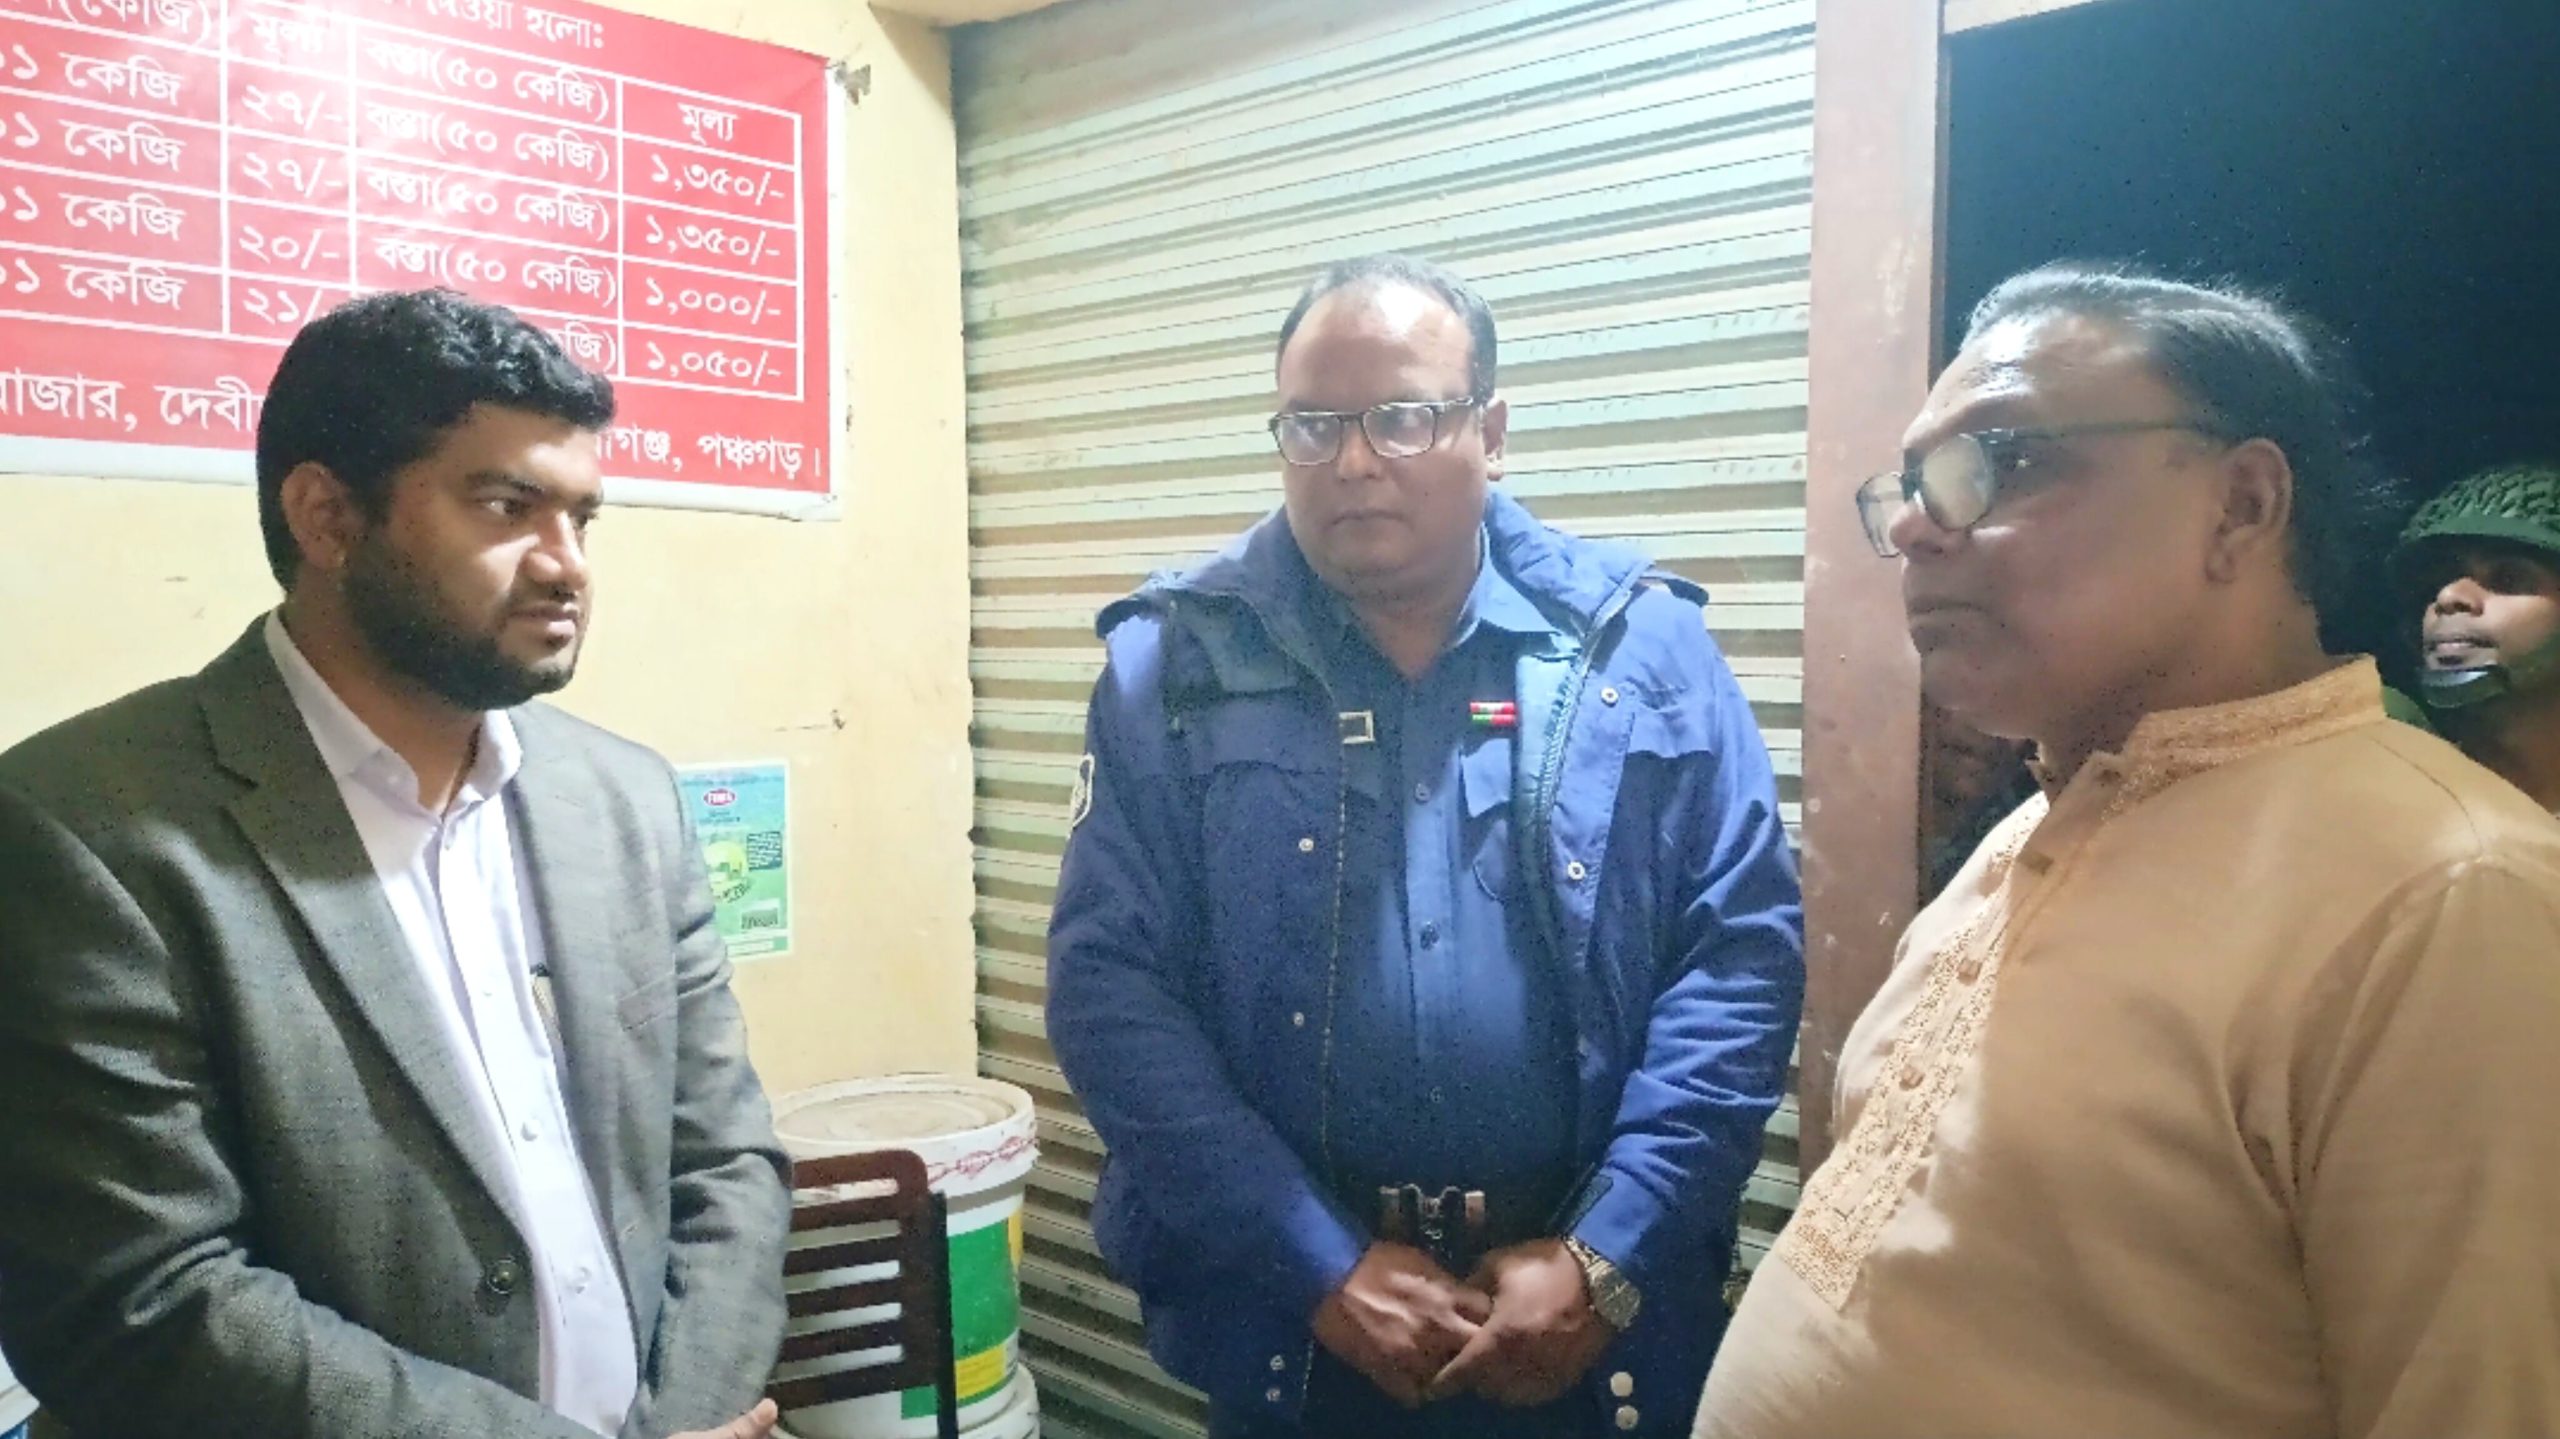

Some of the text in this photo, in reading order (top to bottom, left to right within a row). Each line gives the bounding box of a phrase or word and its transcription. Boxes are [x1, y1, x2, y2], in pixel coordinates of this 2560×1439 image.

[0, 44, 186, 106] ১ কেজি
[513, 66, 609, 122] কেজি)
[240, 84, 344, 132] ২৭/-
[678, 102, 739, 146] মূল্য
[0, 112, 187, 172] ১ কেজি
[514, 128, 609, 182] কেজি)
[241, 151, 344, 199] ২৭/-
[651, 153, 785, 206] ১,৩৫০/-
[0, 186, 187, 241] ১ কেজি
[514, 189, 609, 242] কেজি)
[646, 214, 781, 266] ১,৩৫০/-
[238, 225, 341, 271] ২০/-
[373, 237, 616, 308] বস্তা(৫০ কেজি)
[0, 258, 188, 310] ১ কেজি
[646, 277, 782, 326] ১,০০০/-
[646, 341, 782, 387] ১,০৫০/-
[154, 376, 266, 432] দেবী
